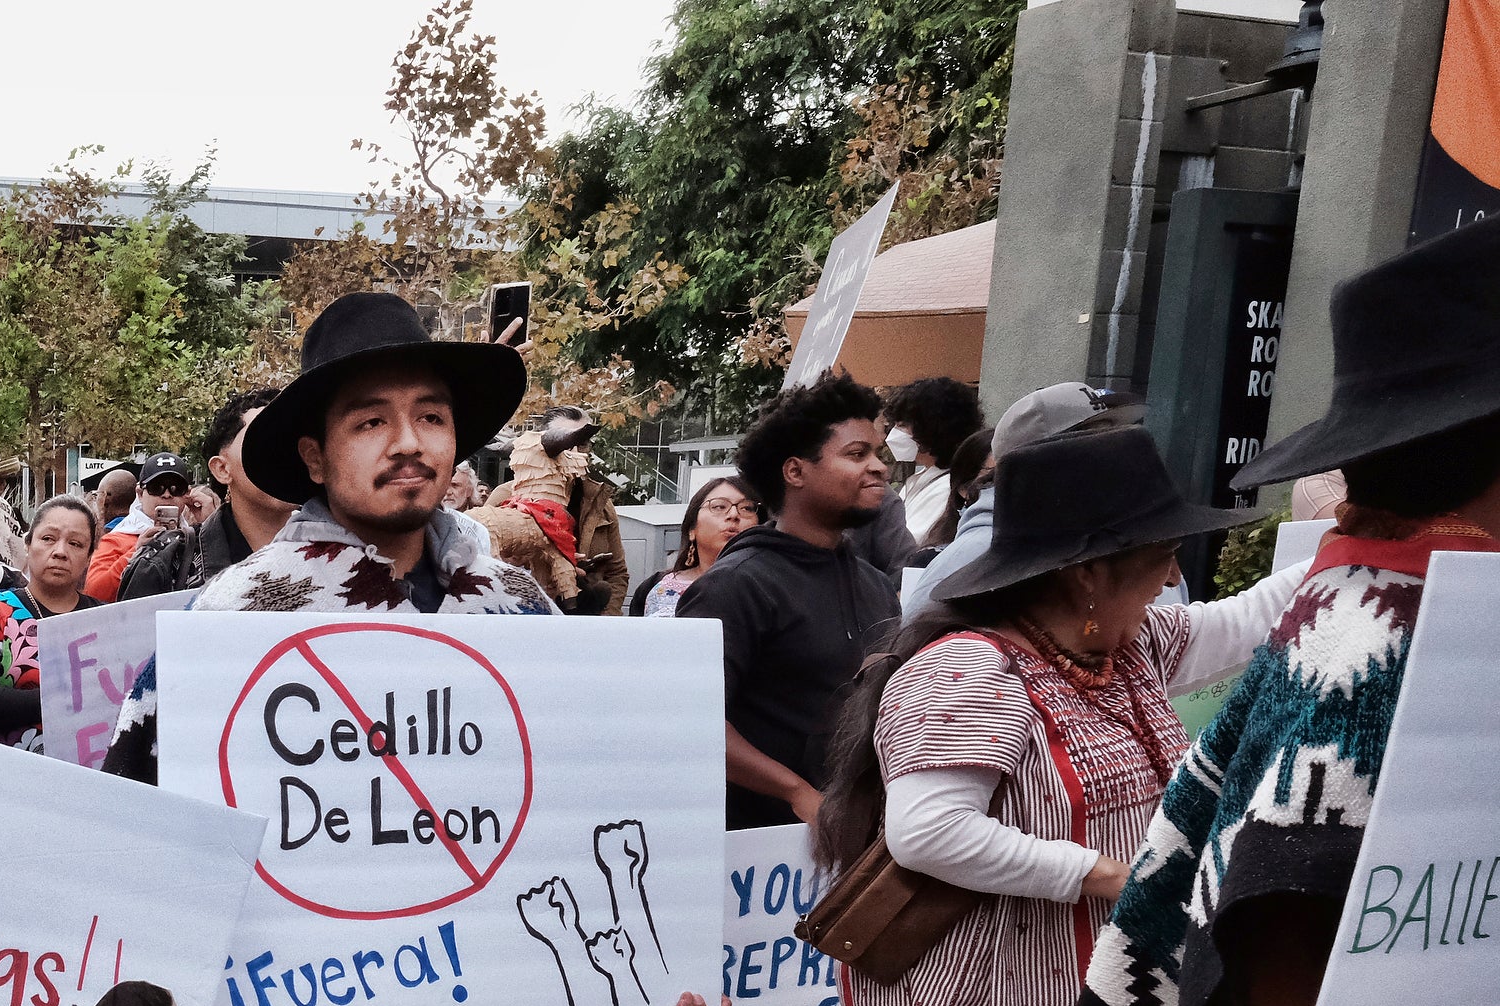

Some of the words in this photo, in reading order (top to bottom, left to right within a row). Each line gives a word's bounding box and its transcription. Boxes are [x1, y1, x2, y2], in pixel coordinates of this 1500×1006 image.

[264, 682, 483, 765] Cedillo
[280, 776, 351, 850] De
[371, 776, 500, 846] Leon
